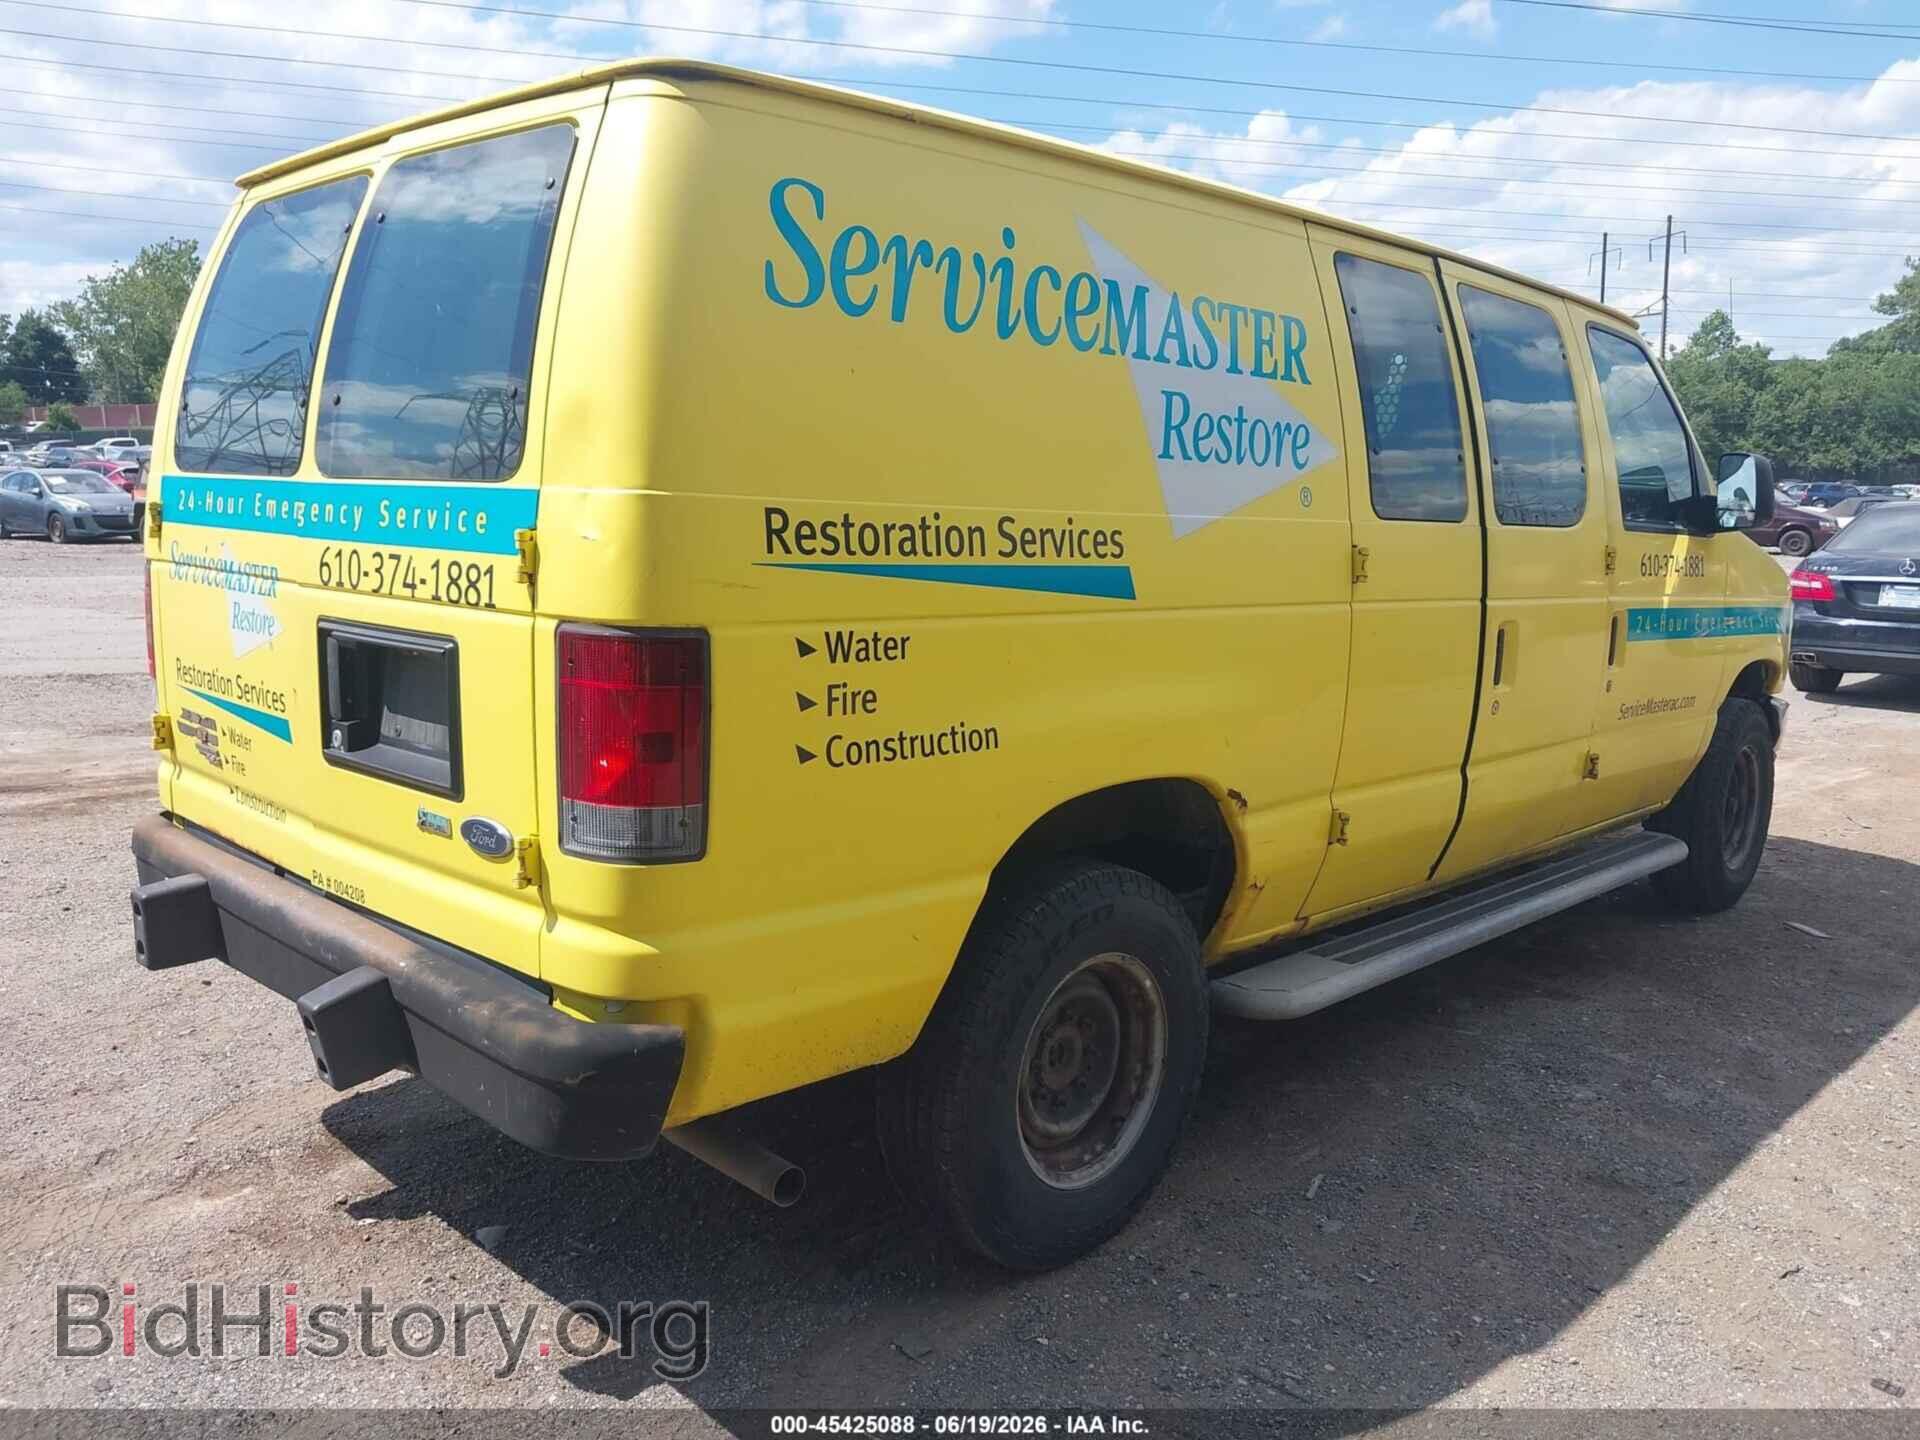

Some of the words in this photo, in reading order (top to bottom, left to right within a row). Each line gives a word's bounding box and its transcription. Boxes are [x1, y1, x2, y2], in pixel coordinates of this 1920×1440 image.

[765, 178, 1311, 385] ServiceMASTER
[1157, 390, 1310, 470] Restore
[178, 489, 243, 515] 24-Hour
[255, 492, 363, 532] Emergency
[378, 499, 488, 534] Service
[764, 507, 986, 558] Restoration
[997, 513, 1124, 560] Services
[319, 546, 497, 608] 610-374-1881
[1640, 553, 1705, 577] 610-374-1881
[232, 601, 275, 636] Restore
[1636, 614, 1688, 633] 24-Hour
[824, 630, 911, 664] Water
[176, 657, 234, 696] Restoration
[236, 673, 286, 713] Services
[826, 682, 877, 717] Fire
[227, 726, 252, 752] Water
[825, 722, 999, 768] Construction
[231, 755, 246, 777] Fire
[234, 785, 288, 824] Construction
[470, 824, 497, 849] Ford
[312, 869, 325, 887] PA
[333, 881, 366, 904] 004208
